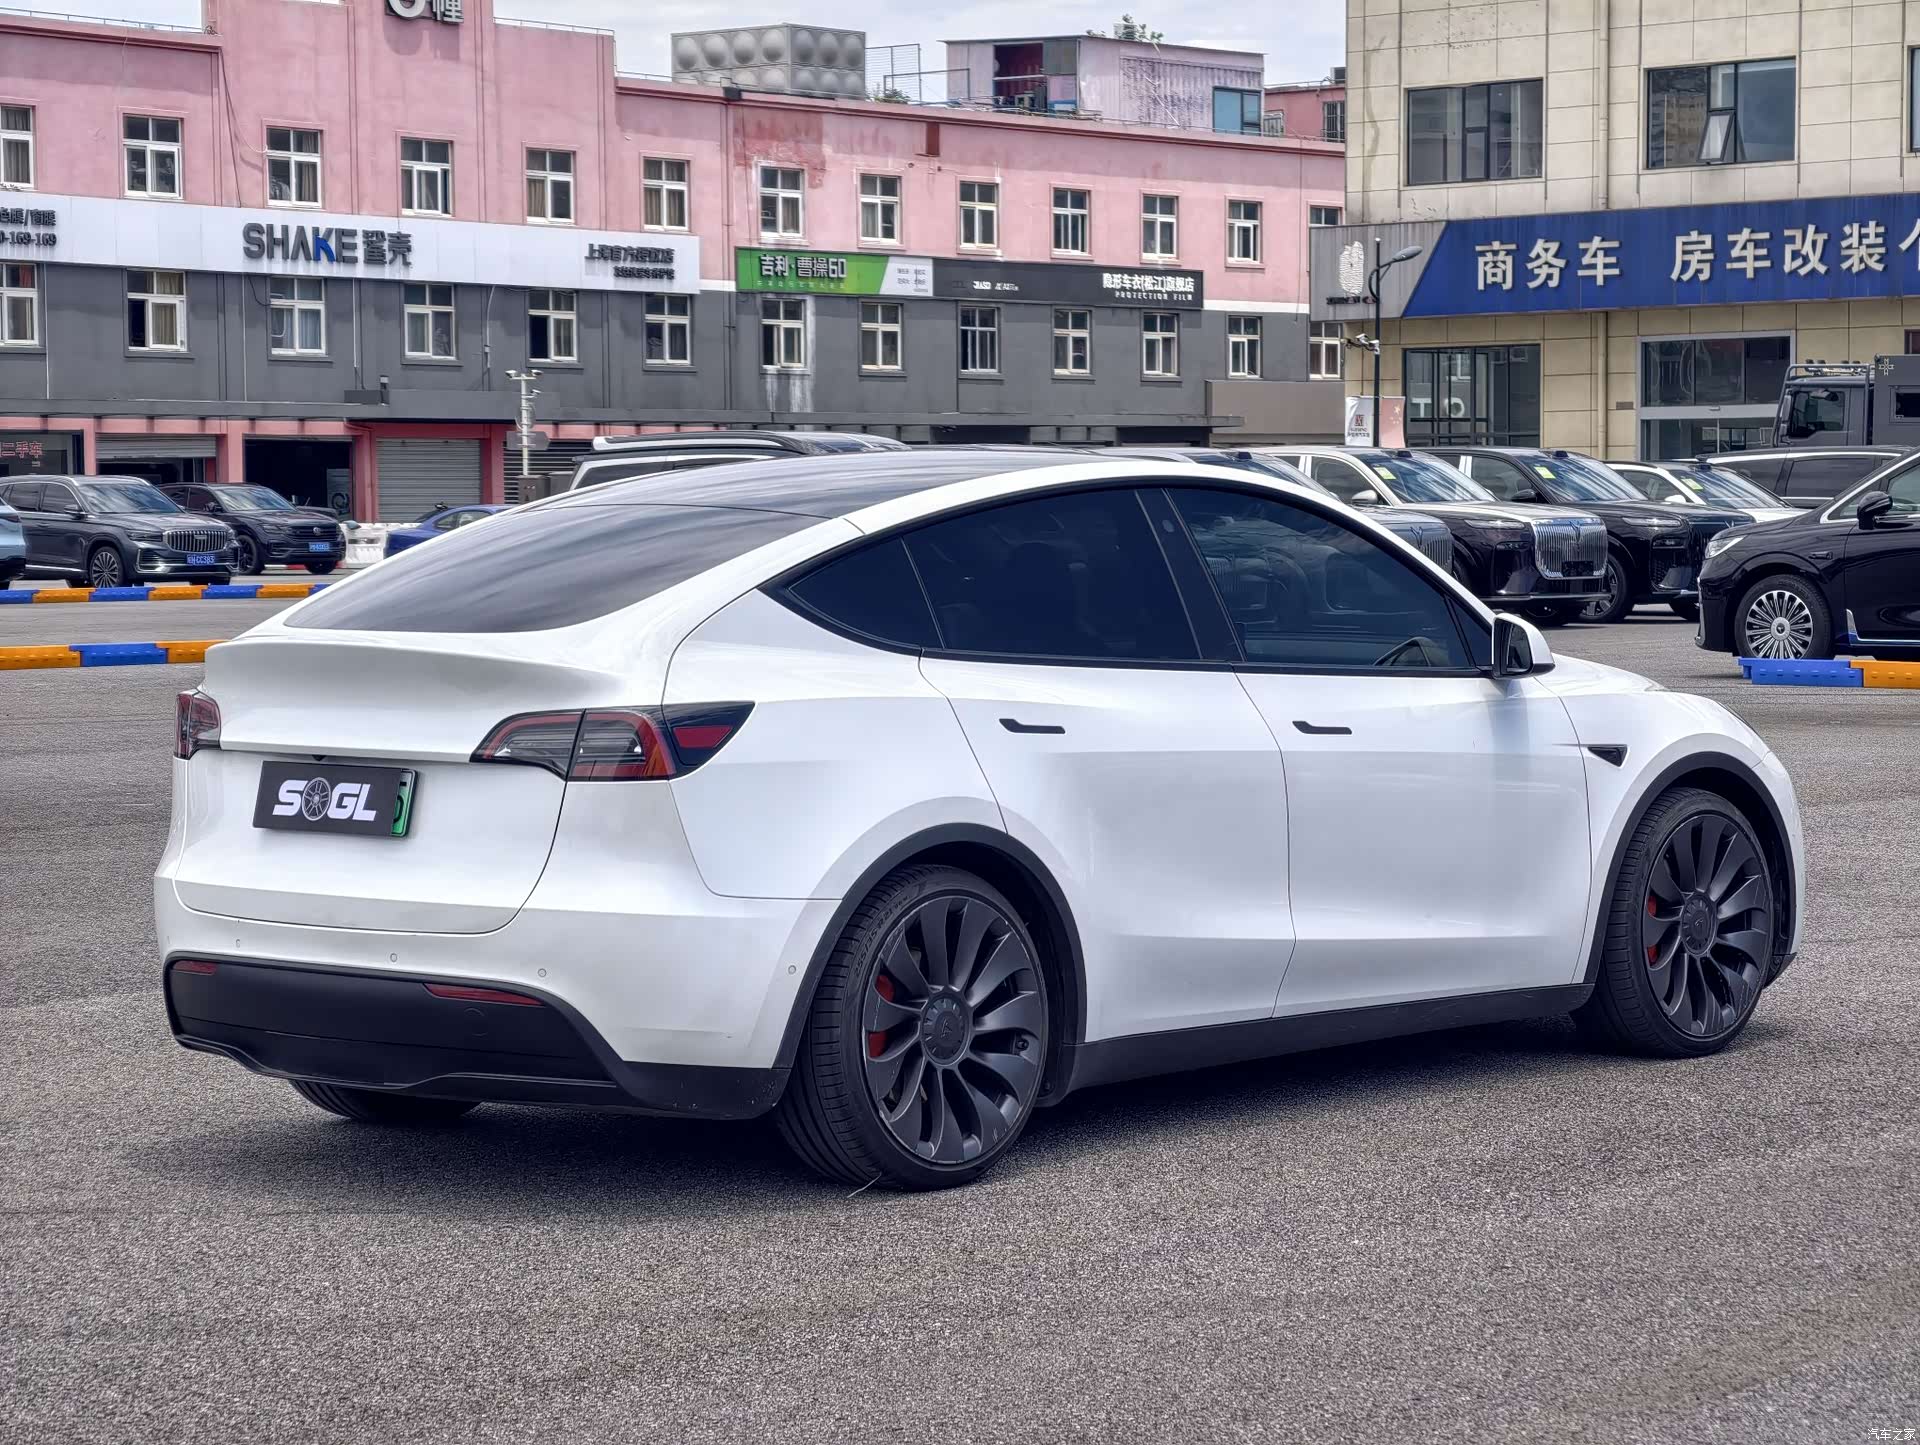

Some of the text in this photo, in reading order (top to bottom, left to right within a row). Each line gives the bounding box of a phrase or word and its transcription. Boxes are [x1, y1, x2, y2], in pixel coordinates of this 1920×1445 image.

[242, 222, 358, 265] SHAKE
[1474, 235, 1622, 291] 商务车
[1115, 290, 1193, 301] PROTECTION FILM
[0, 441, 44, 459] 二手车
